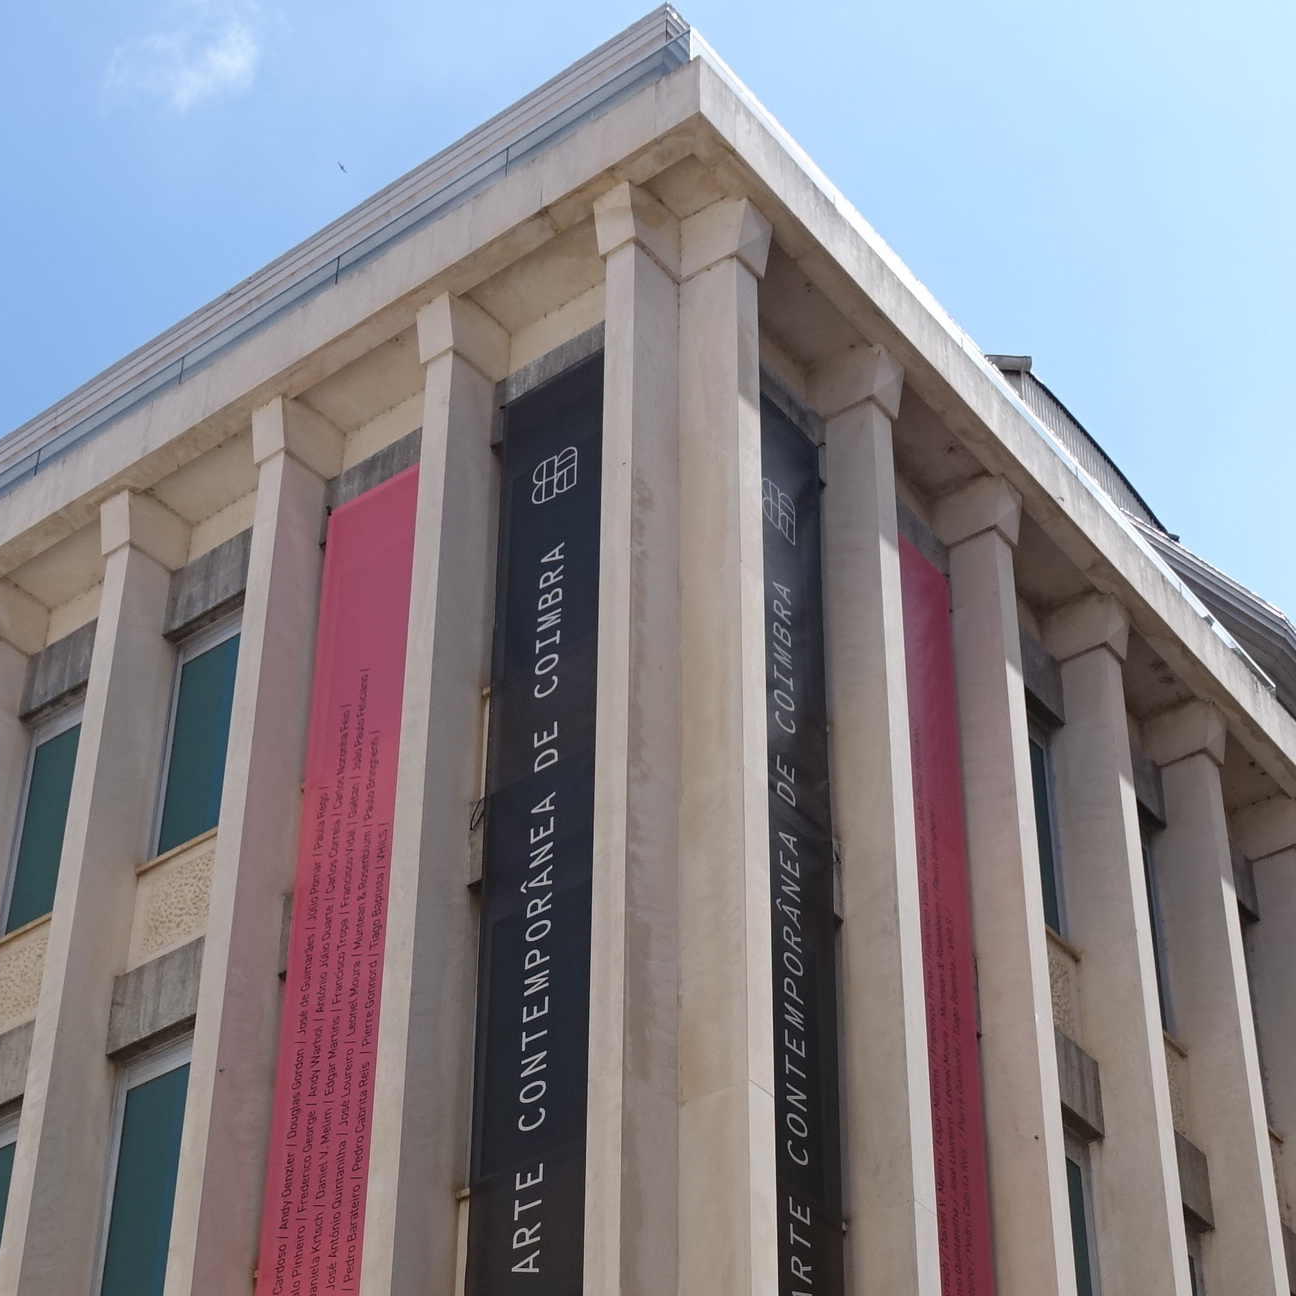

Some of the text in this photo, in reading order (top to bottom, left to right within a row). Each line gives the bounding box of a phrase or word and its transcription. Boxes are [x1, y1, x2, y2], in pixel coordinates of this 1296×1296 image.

[534, 542, 565, 698] COIMBRA
[773, 581, 796, 734] COIMBRA
[533, 720, 560, 772] DE
[776, 755, 796, 807] DE
[309, 860, 321, 895] Pomar
[371, 872, 384, 916] Baptista
[307, 895, 318, 922] Júlio
[321, 903, 333, 940] Duarte
[352, 901, 366, 950] Muntean
[337, 917, 350, 949] Tropa
[369, 918, 382, 949] Tiago
[319, 942, 330, 968] Júlio
[518, 791, 556, 1132] CONTEMPORÂNEA
[315, 971, 328, 1013] António
[332, 950, 345, 1006] Francisco
[349, 960, 361, 996] Moura
[365, 960, 377, 1008] Gonnord
[776, 831, 809, 1166] CONTEMPORÂNEA
[299, 993, 309, 1008] de
[345, 998, 358, 1037] Leonel
[296, 1010, 308, 1036] José
[328, 1014, 340, 1060] Martins
[361, 1010, 374, 1046] Pierre
[310, 1025, 323, 1068] Warhol
[291, 1048, 304, 1090] Gordon
[307, 1068, 321, 1098] Andy
[324, 1062, 338, 1096] Edgar
[341, 1048, 354, 1097] Loureiro
[358, 1060, 370, 1088] Reis
[287, 1090, 302, 1140] Douglas
[303, 1110, 317, 1152] George
[320, 1106, 333, 1144] Melim
[338, 1098, 350, 1126] José
[355, 1088, 367, 1134] Cabrita
[319, 1145, 329, 1158] V.
[352, 1134, 364, 1172] Pedro
[281, 1152, 295, 1198] Denzler
[297, 1154, 312, 1212] Frederico
[315, 1160, 328, 1200] Daniel
[332, 1140, 347, 1210] Quintanilha
[278, 1200, 293, 1230] Andy
[347, 1184, 360, 1240] Barateiro
[510, 1162, 544, 1274] ARTE
[292, 1224, 306, 1278] Pinheiro
[327, 1210, 341, 1258] António
[325, 1260, 337, 1291] José
[343, 1244, 356, 1282] Pedro
